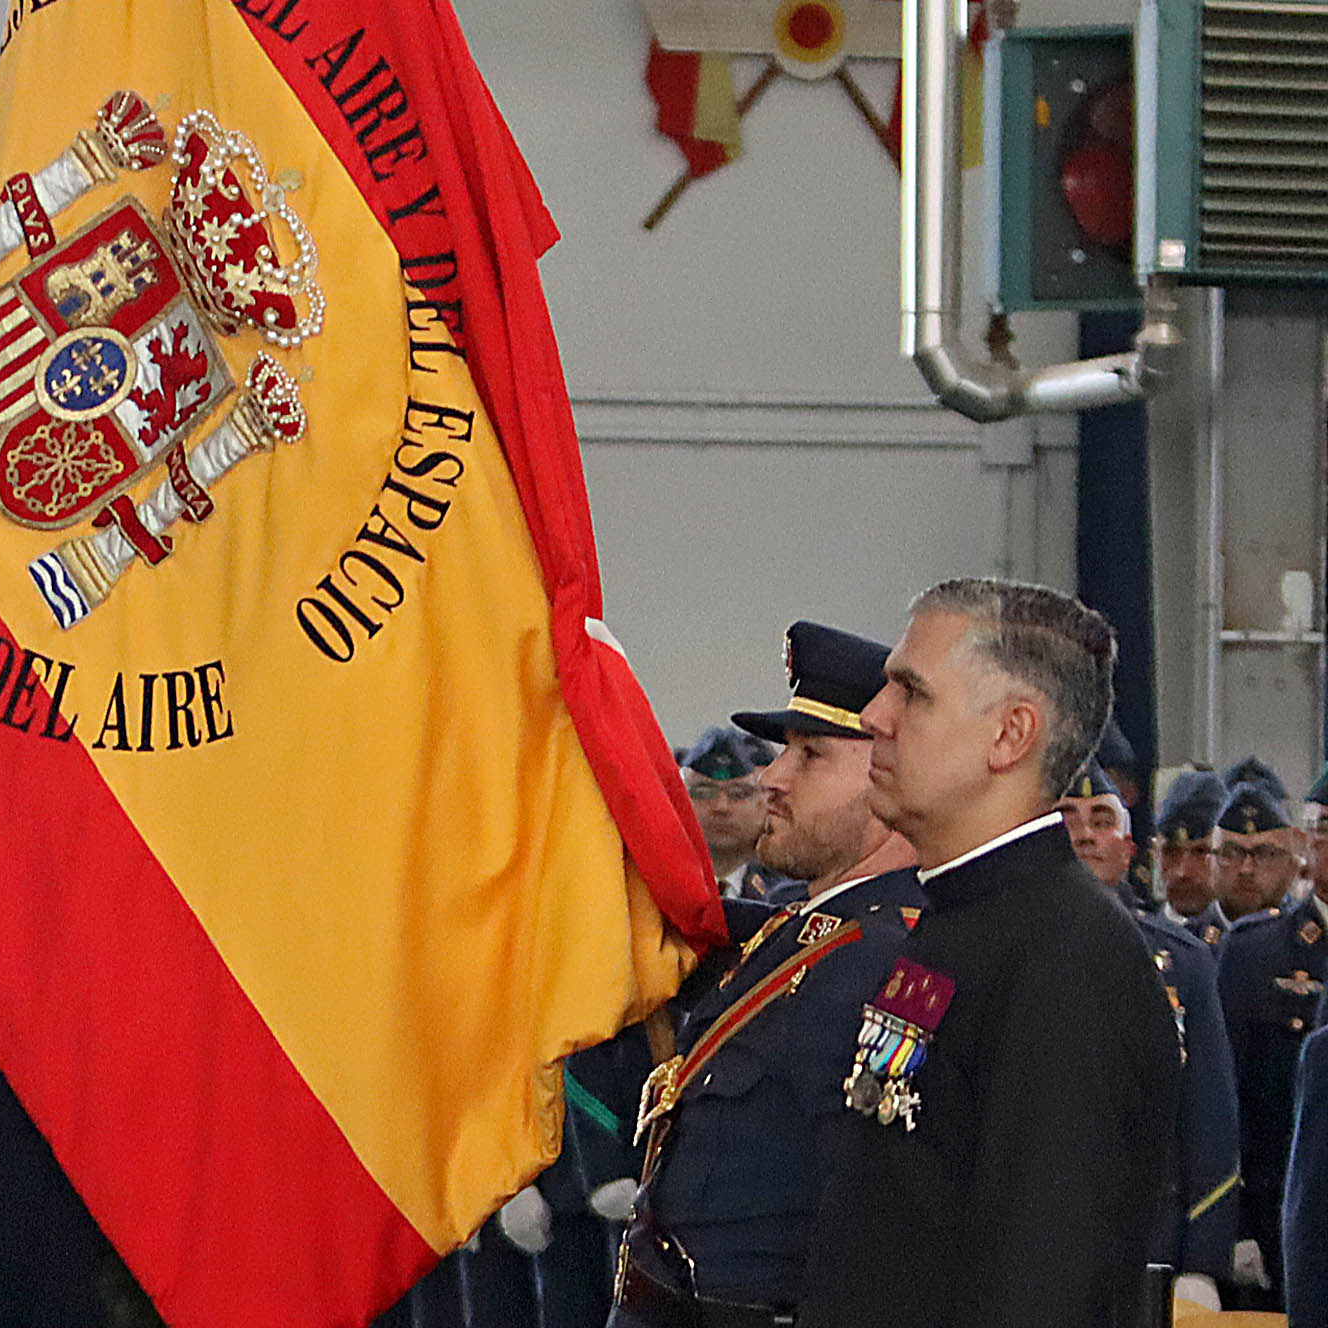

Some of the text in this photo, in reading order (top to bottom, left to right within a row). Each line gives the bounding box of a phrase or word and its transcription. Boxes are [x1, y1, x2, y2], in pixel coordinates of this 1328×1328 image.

[304, 27, 429, 183] AIRE
[11, 178, 51, 248] PLVS
[386, 183, 448, 227] Y
[400, 249, 468, 374] DEL
[295, 394, 476, 663] ESPACIO
[92, 659, 235, 753] AIRE
